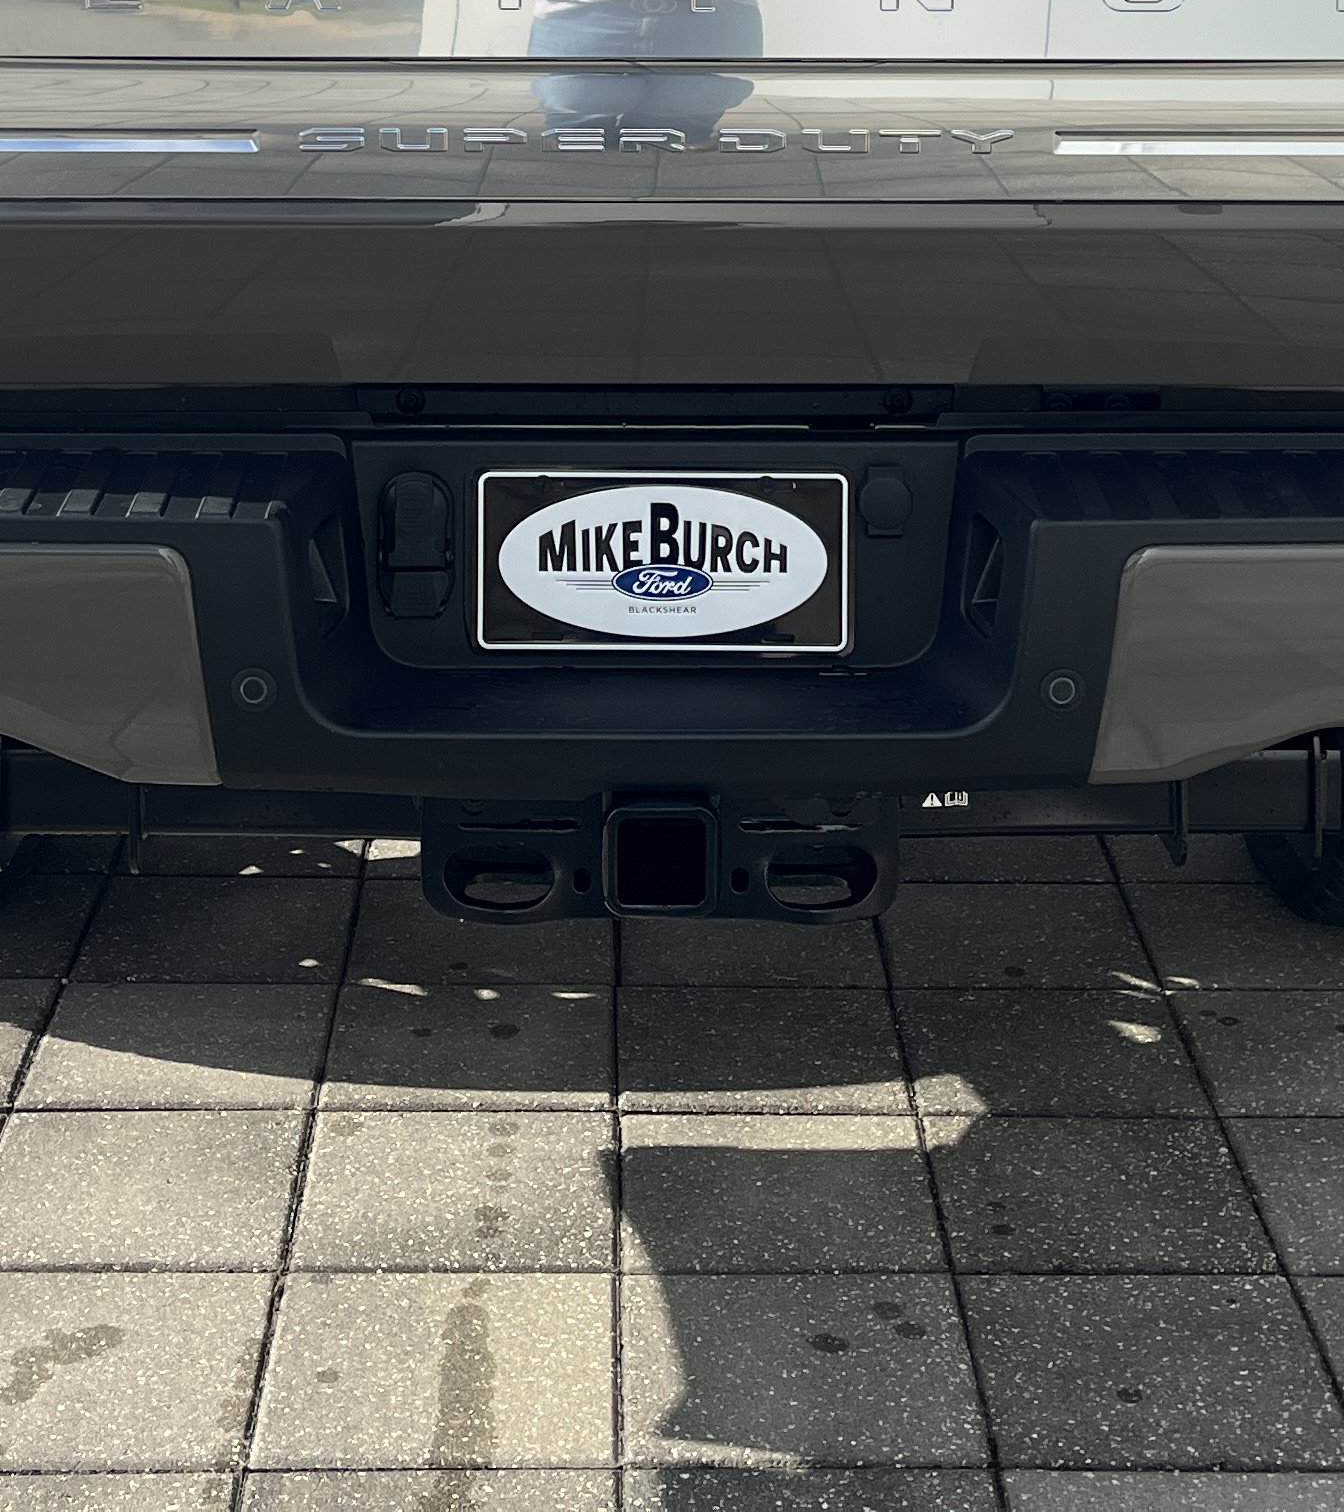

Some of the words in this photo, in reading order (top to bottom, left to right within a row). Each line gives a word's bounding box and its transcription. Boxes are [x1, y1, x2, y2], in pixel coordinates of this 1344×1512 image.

[298, 127, 686, 154] SUPER
[718, 128, 1014, 155] DUTY
[538, 519, 643, 573] MIKE
[650, 502, 788, 574] BURCH
[632, 569, 693, 596] Ford
[628, 605, 697, 615] BLACKSHEAR
